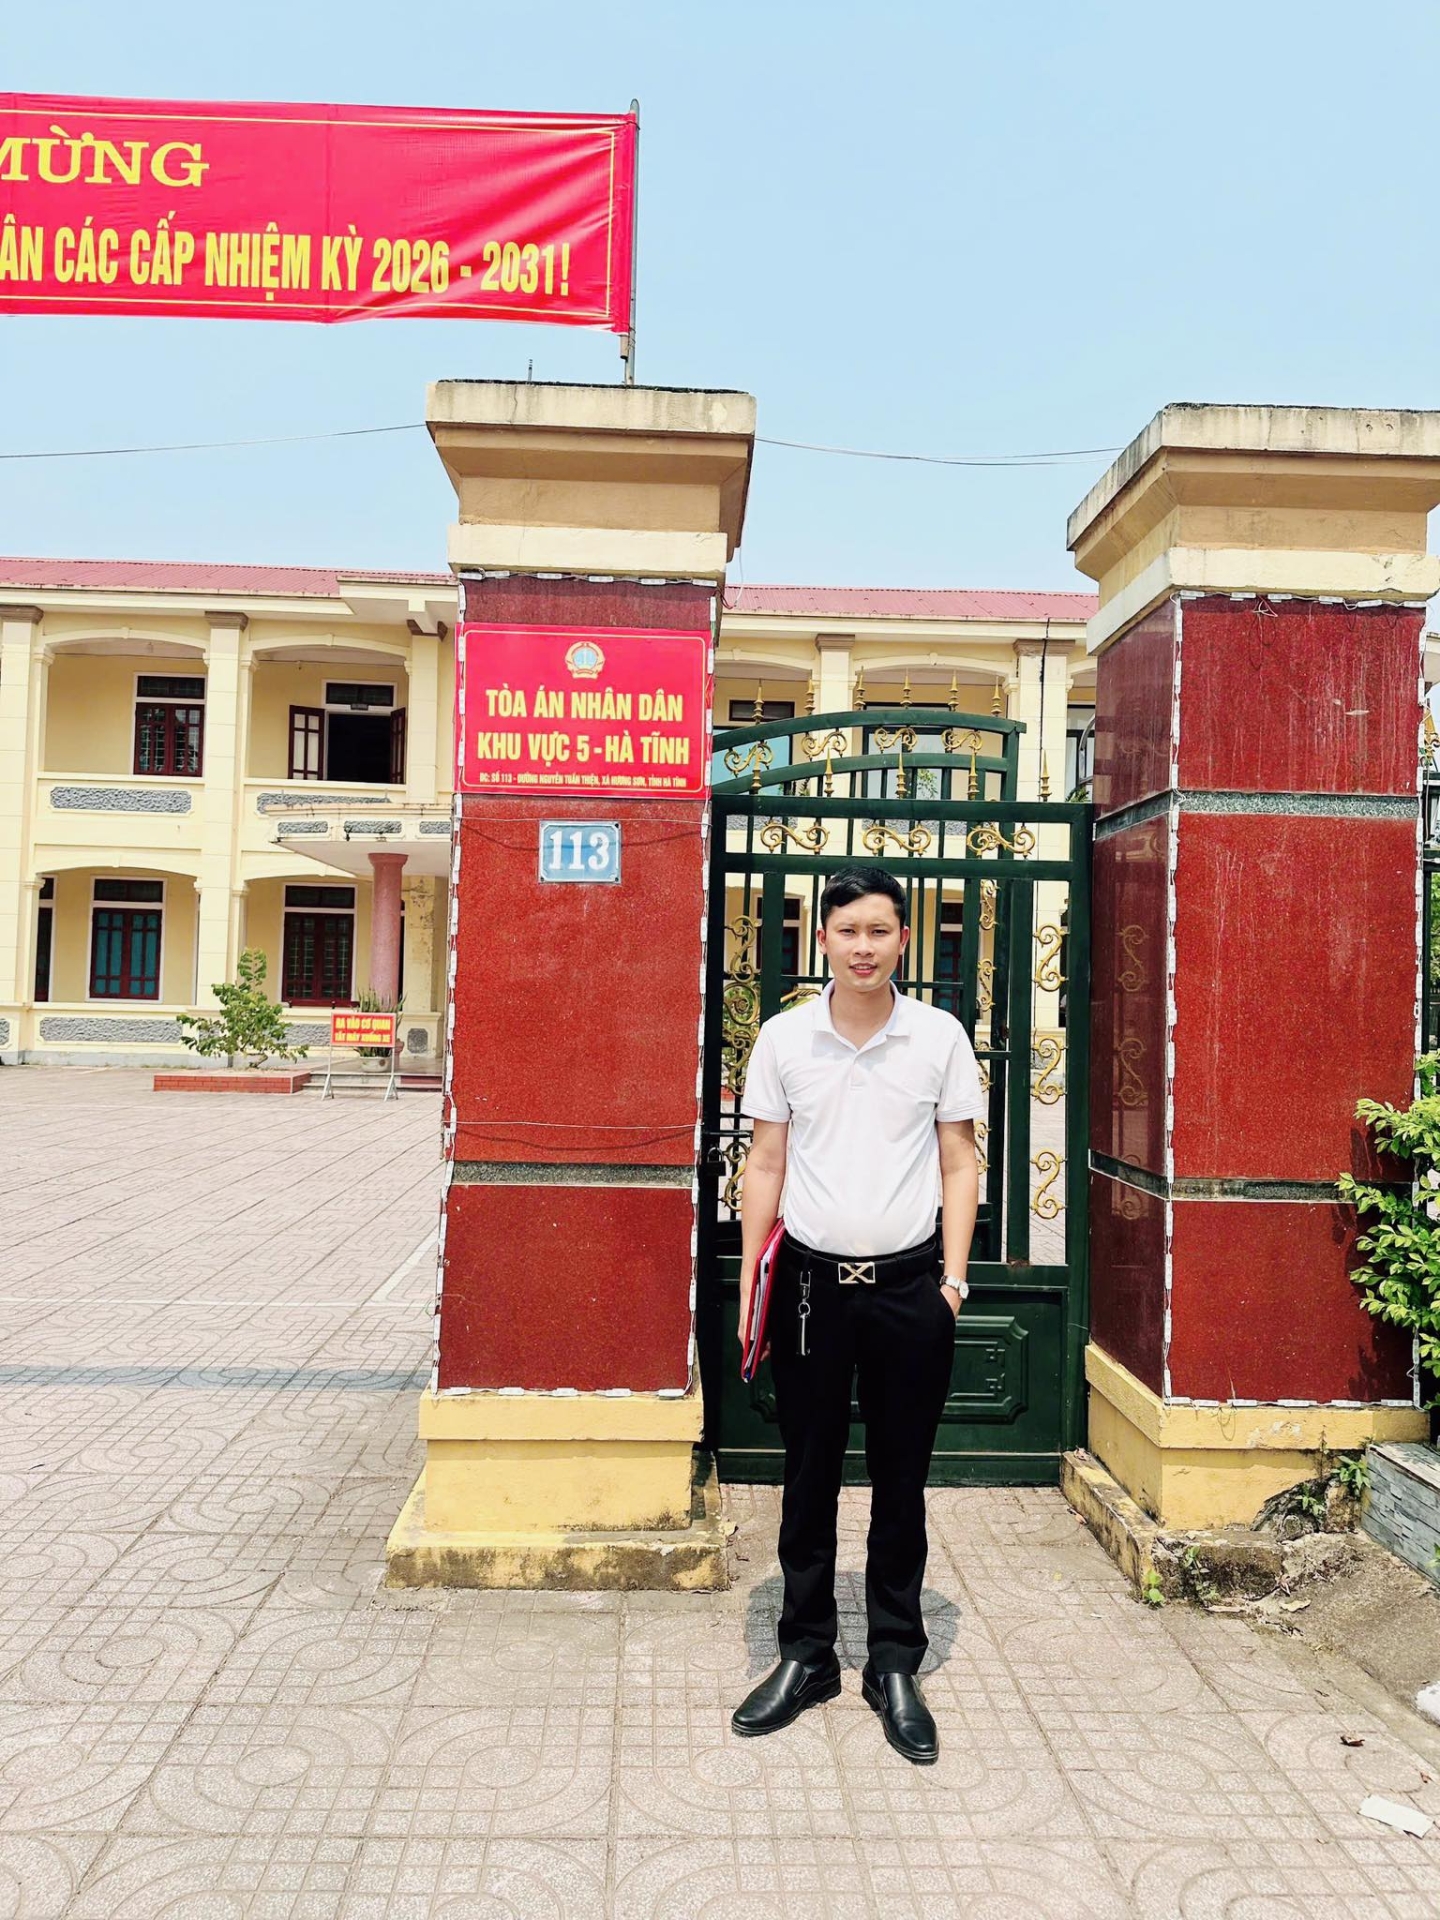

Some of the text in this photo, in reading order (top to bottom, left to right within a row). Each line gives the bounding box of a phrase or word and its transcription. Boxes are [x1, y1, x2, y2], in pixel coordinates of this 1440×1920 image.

[54, 216, 119, 285] CÁC
[130, 210, 195, 286] CẤP
[204, 222, 311, 301] NHIỆM
[321, 225, 363, 291] KỲ
[372, 237, 450, 294] 2026
[480, 241, 570, 296] 2031!
[485, 683, 684, 722] TÒA ÁN NHÂN DÂN
[477, 732, 521, 760] KHU
[527, 731, 570, 768] VỰC
[640, 731, 690, 765] TĨNH
[501, 773, 512, 783] 113
[548, 830, 610, 871] 113
